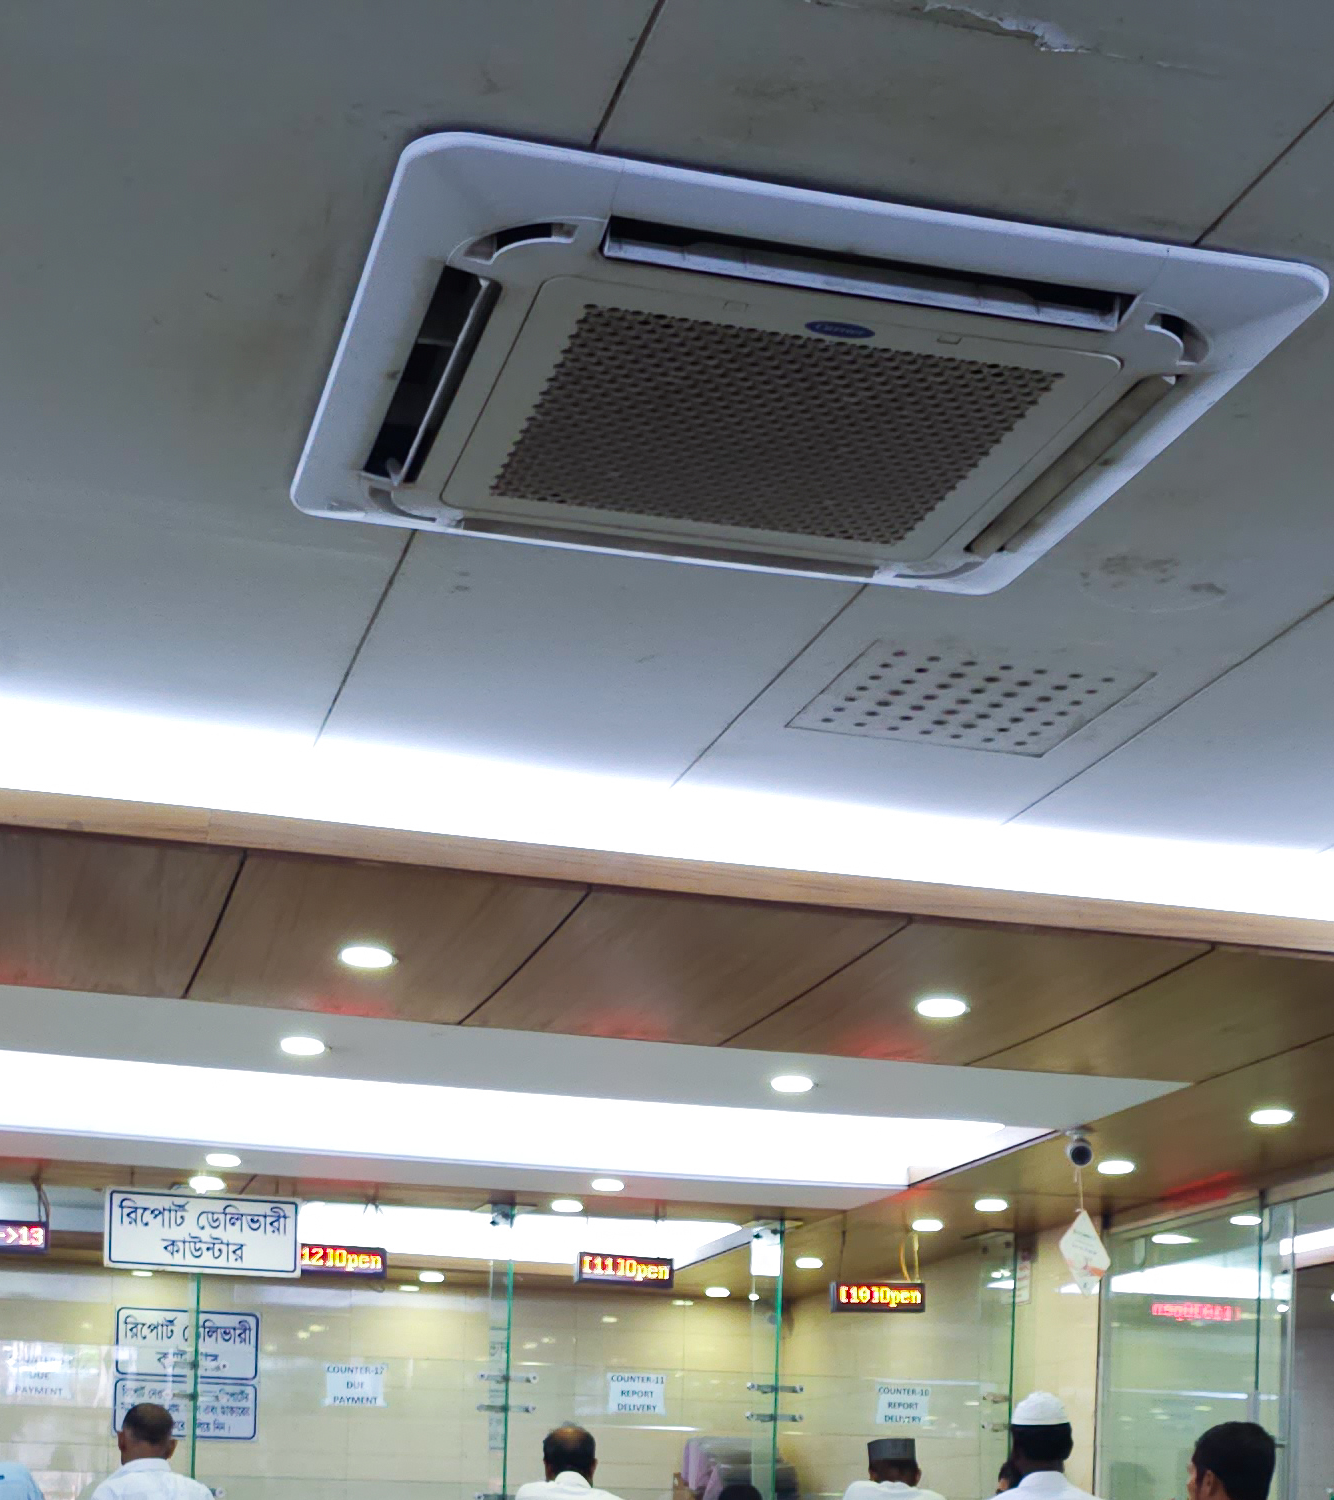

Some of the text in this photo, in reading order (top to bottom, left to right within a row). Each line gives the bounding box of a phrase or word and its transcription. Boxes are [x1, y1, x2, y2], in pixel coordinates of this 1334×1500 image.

[119, 1198, 290, 1235] রিপোর্ট ডেলিভারী
[161, 1233, 246, 1264] কাউন্টার
[300, 1247, 382, 1272] 12]Open
[582, 1256, 670, 1281] [11]Open
[839, 1286, 922, 1308] [10]Open
[124, 1315, 177, 1341] রিপোর্ট
[611, 1374, 664, 1384] COUNTER-11
[620, 1389, 654, 1398] REPORT
[878, 1386, 929, 1397] COUNTER-10
[333, 1396, 378, 1405] PAYMENT
[617, 1403, 657, 1412] DELIVERY
[887, 1401, 919, 1410] REPORT
